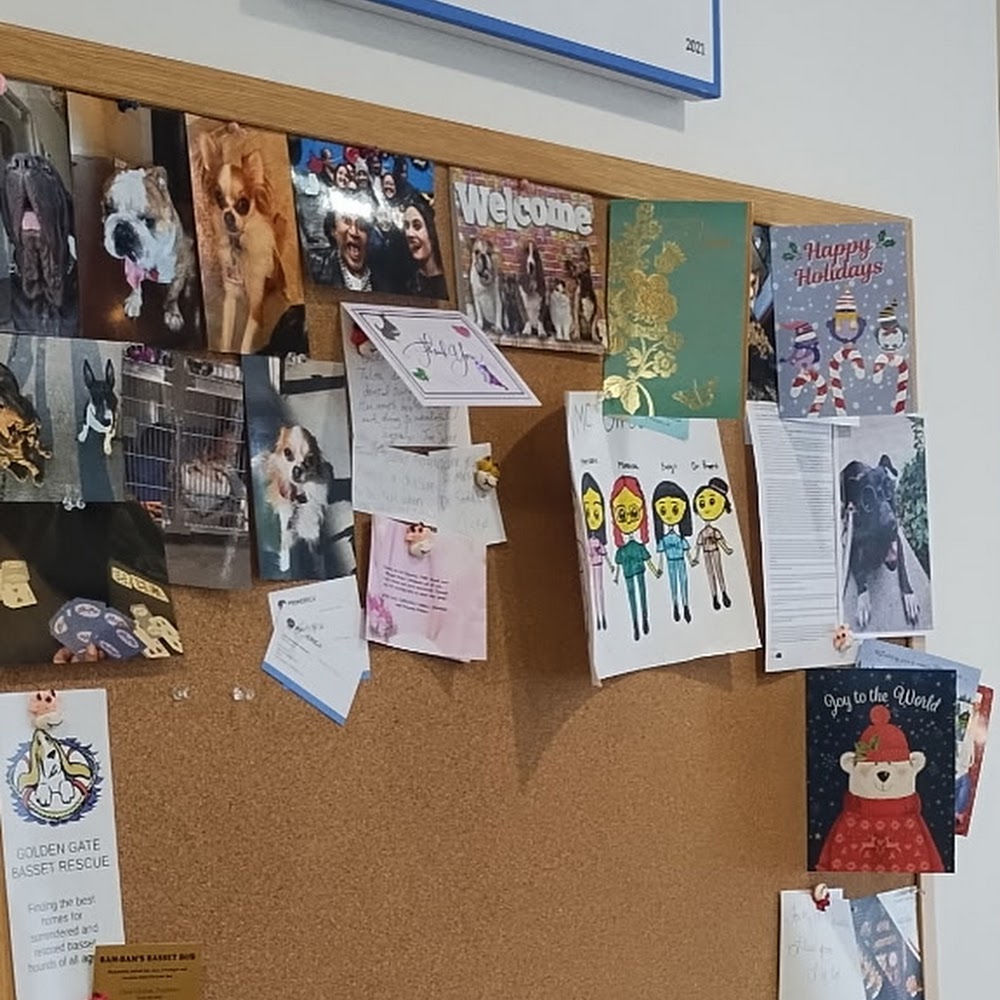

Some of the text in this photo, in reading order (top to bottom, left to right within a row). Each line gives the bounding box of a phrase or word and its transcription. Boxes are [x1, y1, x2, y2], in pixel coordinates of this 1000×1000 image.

[685, 37, 705, 56] 2021
[454, 181, 594, 236] Welcome
[803, 238, 875, 265] Happy
[794, 261, 884, 287] Holidays
[823, 684, 942, 718] Joy to the World
[17, 838, 101, 860] GOLDEN GATE
[12, 855, 110, 879] BASSET RESCUE
[59, 898, 74, 909] the
